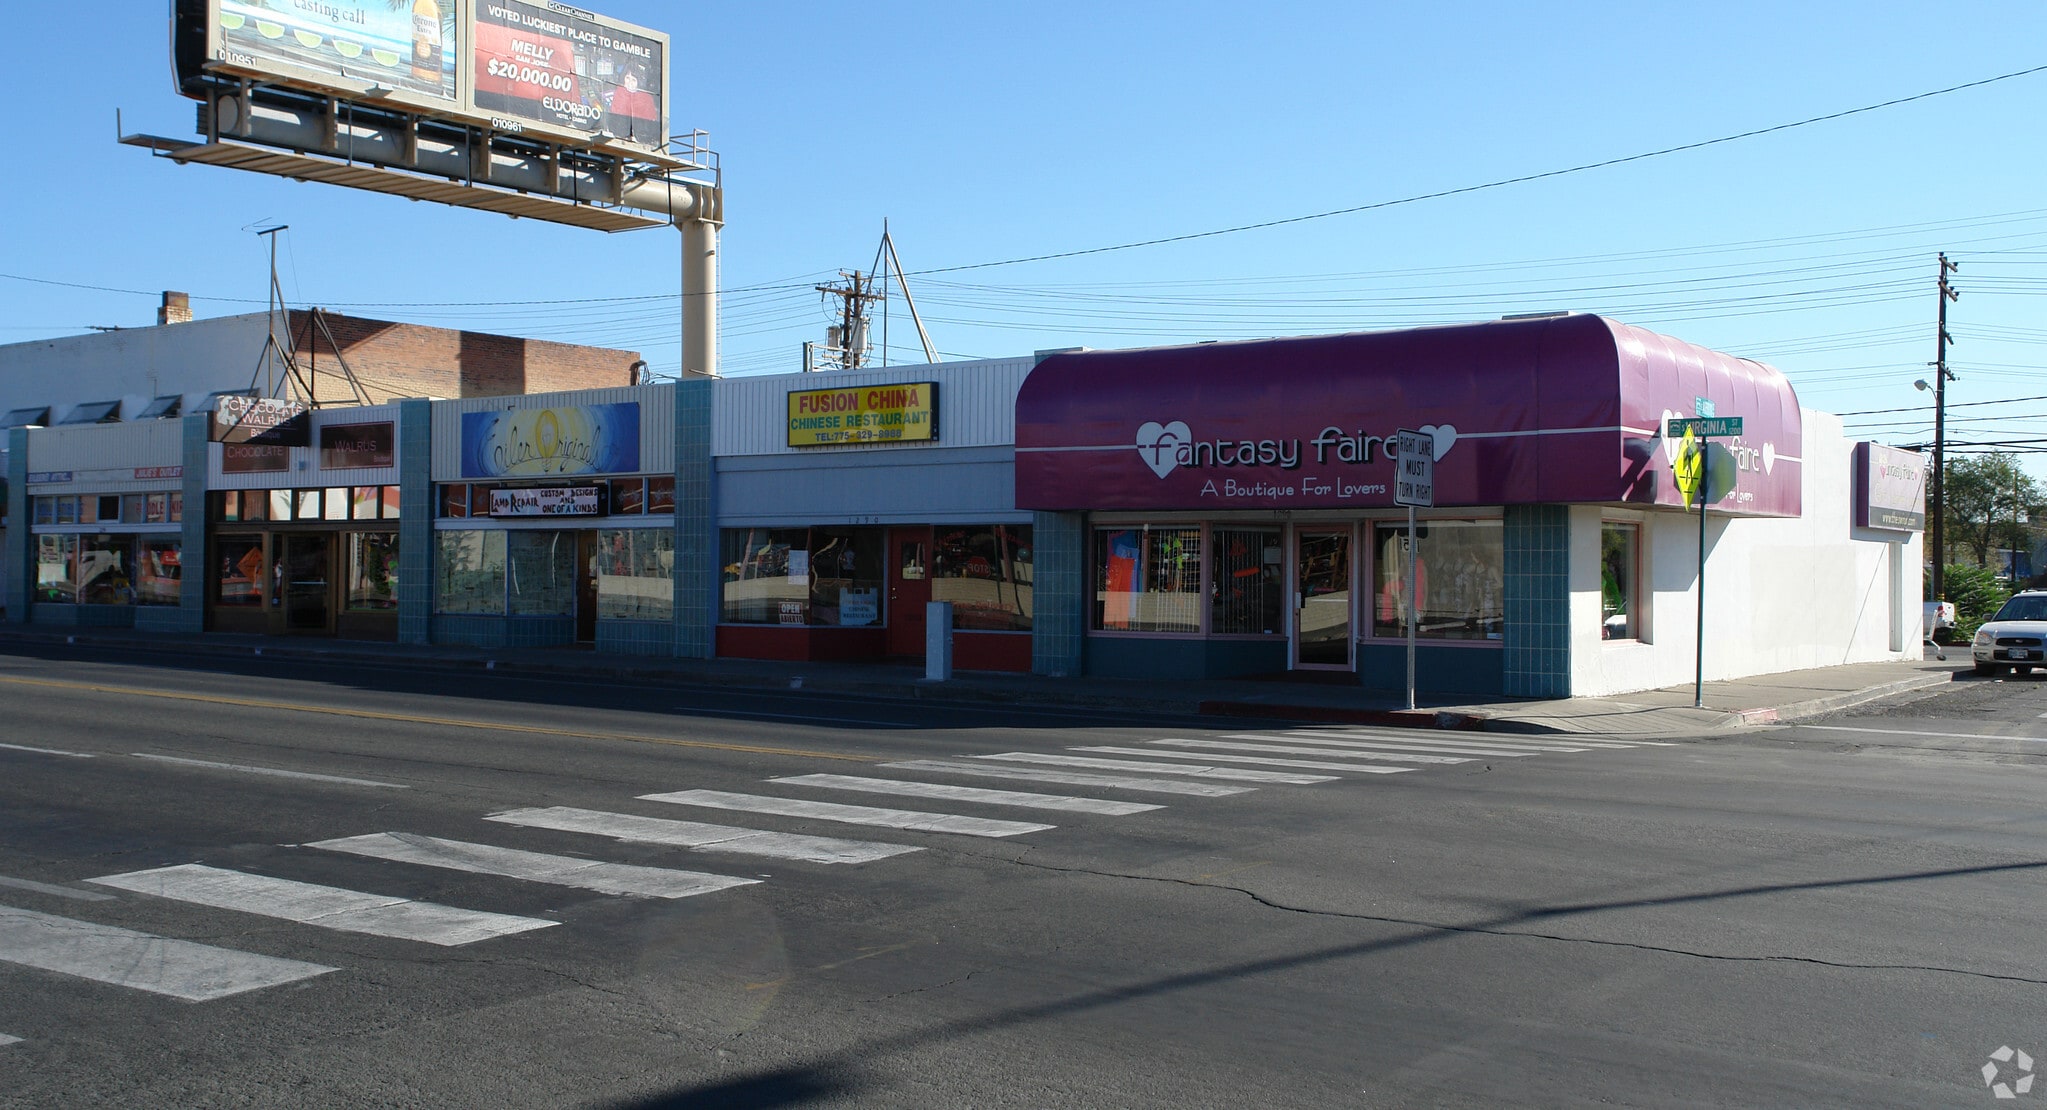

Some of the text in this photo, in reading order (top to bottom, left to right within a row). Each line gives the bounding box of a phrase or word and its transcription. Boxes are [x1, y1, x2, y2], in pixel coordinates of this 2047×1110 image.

[342, 8, 365, 24] call
[488, 4, 651, 58] VOTED LUCKIEST PLACE TO GAMBLE
[218, 47, 257, 66] 010951
[511, 39, 554, 61] MELLY
[487, 57, 572, 92] $20,000.00
[492, 117, 522, 132] 010961
[229, 399, 303, 415] CHOCOLATE
[799, 388, 920, 414] FUSION CHINA
[242, 413, 292, 427] WALRUS
[791, 411, 929, 430] CHINESE RESTAURANT
[227, 446, 284, 458] CHOCOLATE
[334, 439, 377, 453] WALRUS
[1149, 432, 1298, 469] fantasy
[1399, 436, 1431, 457] RIGHT LANE
[159, 466, 182, 477] OUTLET
[1406, 461, 1425, 477] MUST
[540, 488, 598, 498] CUSTOM DESIGNS
[1200, 477, 1386, 500] A Boutique For Lovers
[1398, 481, 1431, 501] TURN RIGHT
[510, 492, 539, 513] REPAIR
[542, 504, 556, 513] ONE
[572, 504, 597, 513] KINDS
[780, 603, 801, 614] OPEN
[780, 615, 803, 623] ABIERTO
